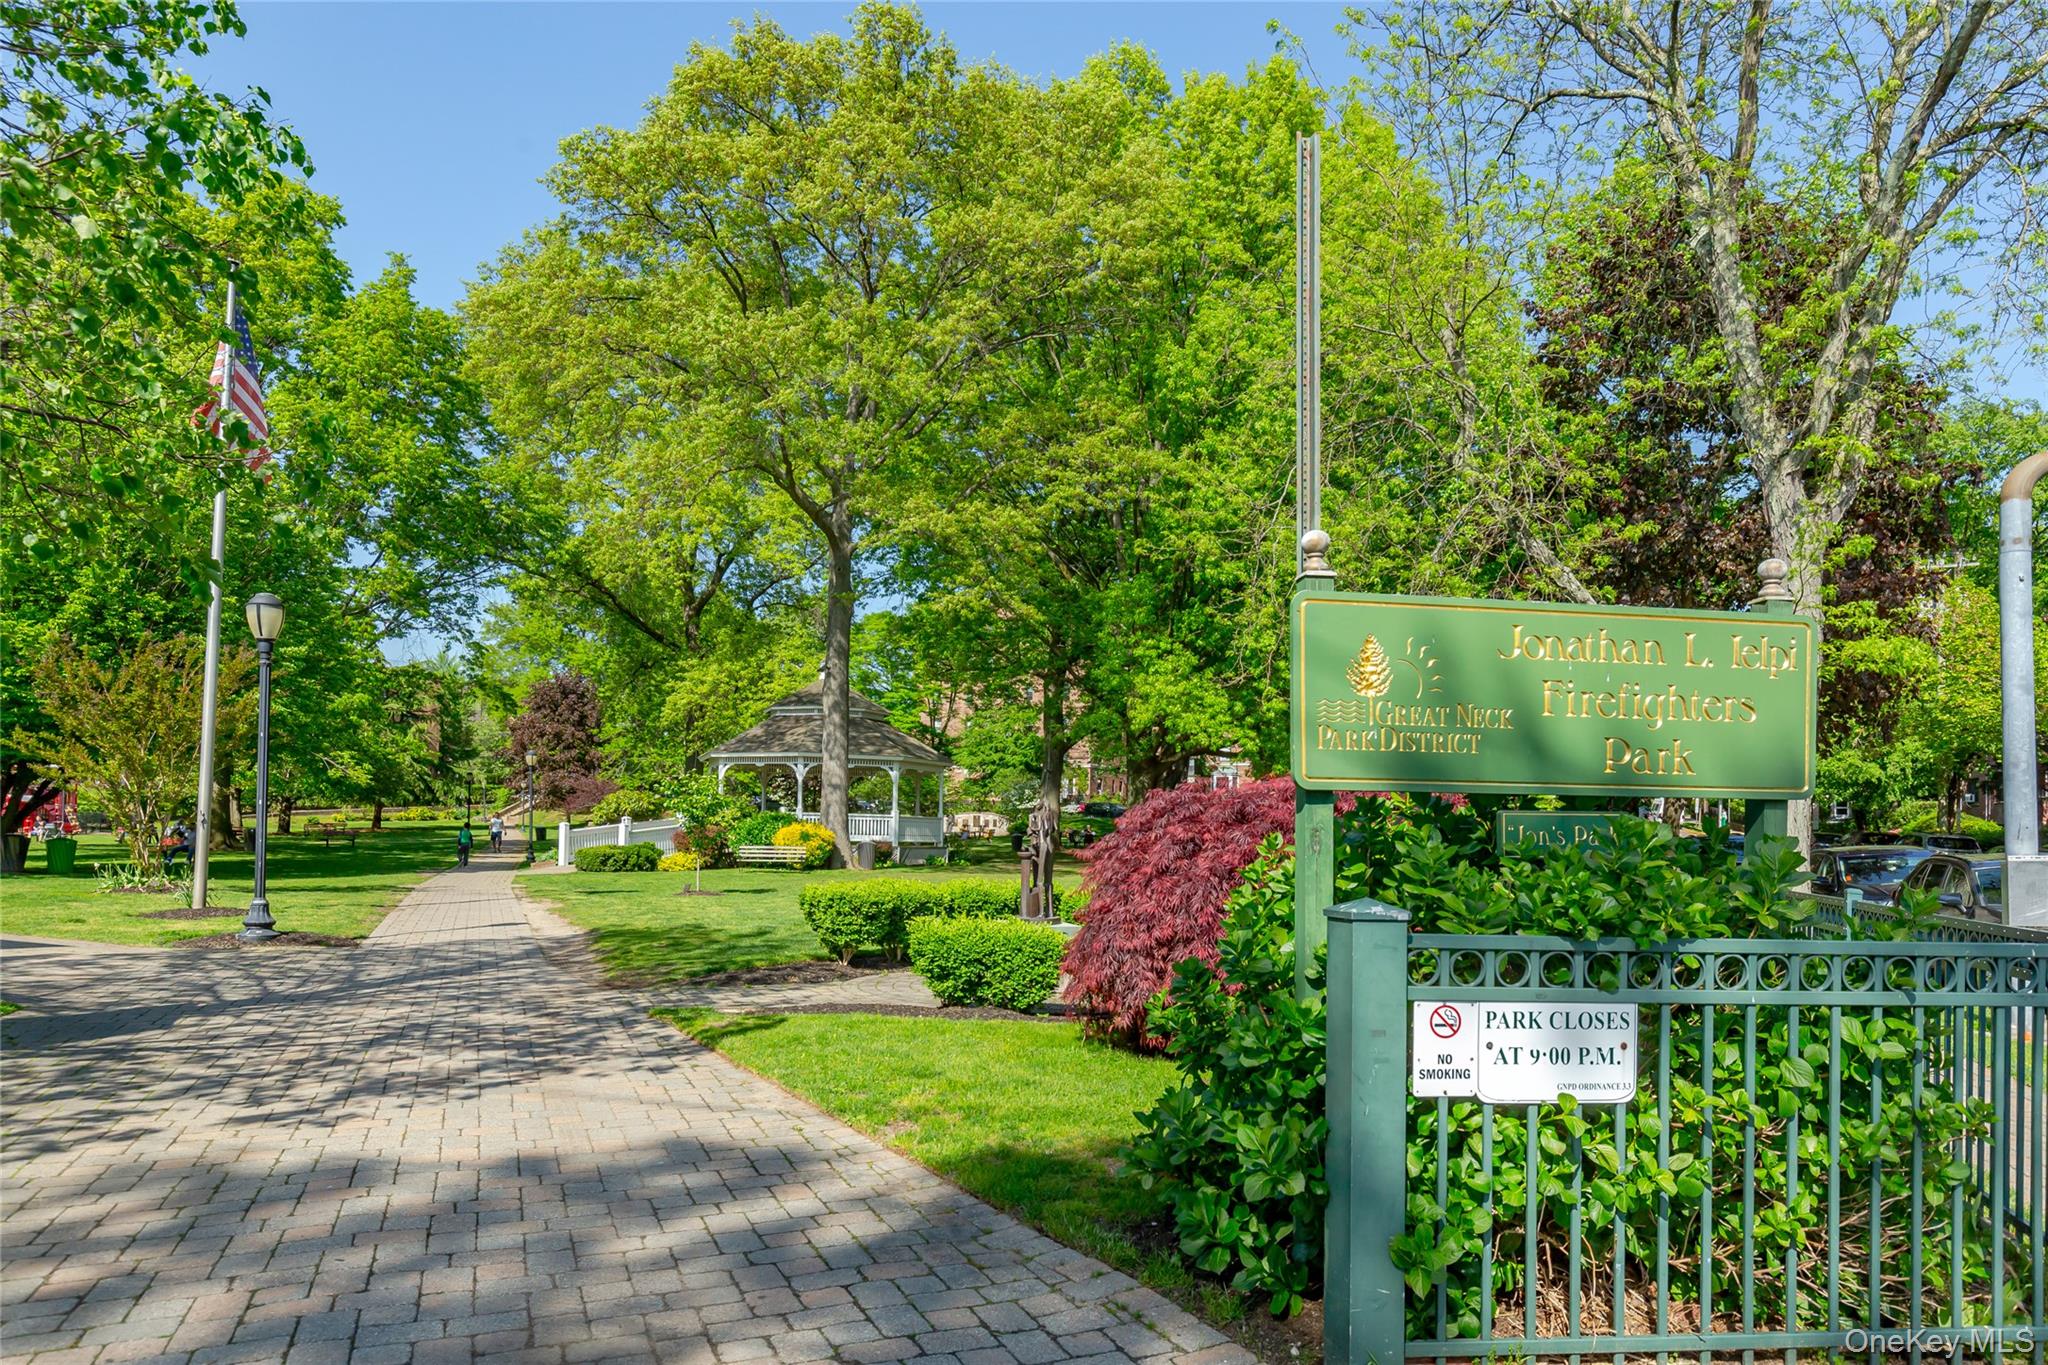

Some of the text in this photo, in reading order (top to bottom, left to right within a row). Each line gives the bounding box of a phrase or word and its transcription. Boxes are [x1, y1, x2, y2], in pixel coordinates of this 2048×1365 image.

[1497, 624, 1798, 679] Jonathan L. Ielpi
[1375, 700, 1515, 730] GREAT NECK
[1542, 679, 1758, 731] Firefighters
[1603, 736, 1697, 776] Park
[1485, 1010, 1631, 1031] PARK CLOSES
[1437, 1053, 1454, 1065] NO
[1493, 1046, 1524, 1066] AT
[1577, 1046, 1622, 1066] P.M.
[1418, 1067, 1472, 1081] SMOKING
[1556, 1081, 1578, 1091] GNPD
[1578, 1082, 1621, 1091] ORDINANCE
